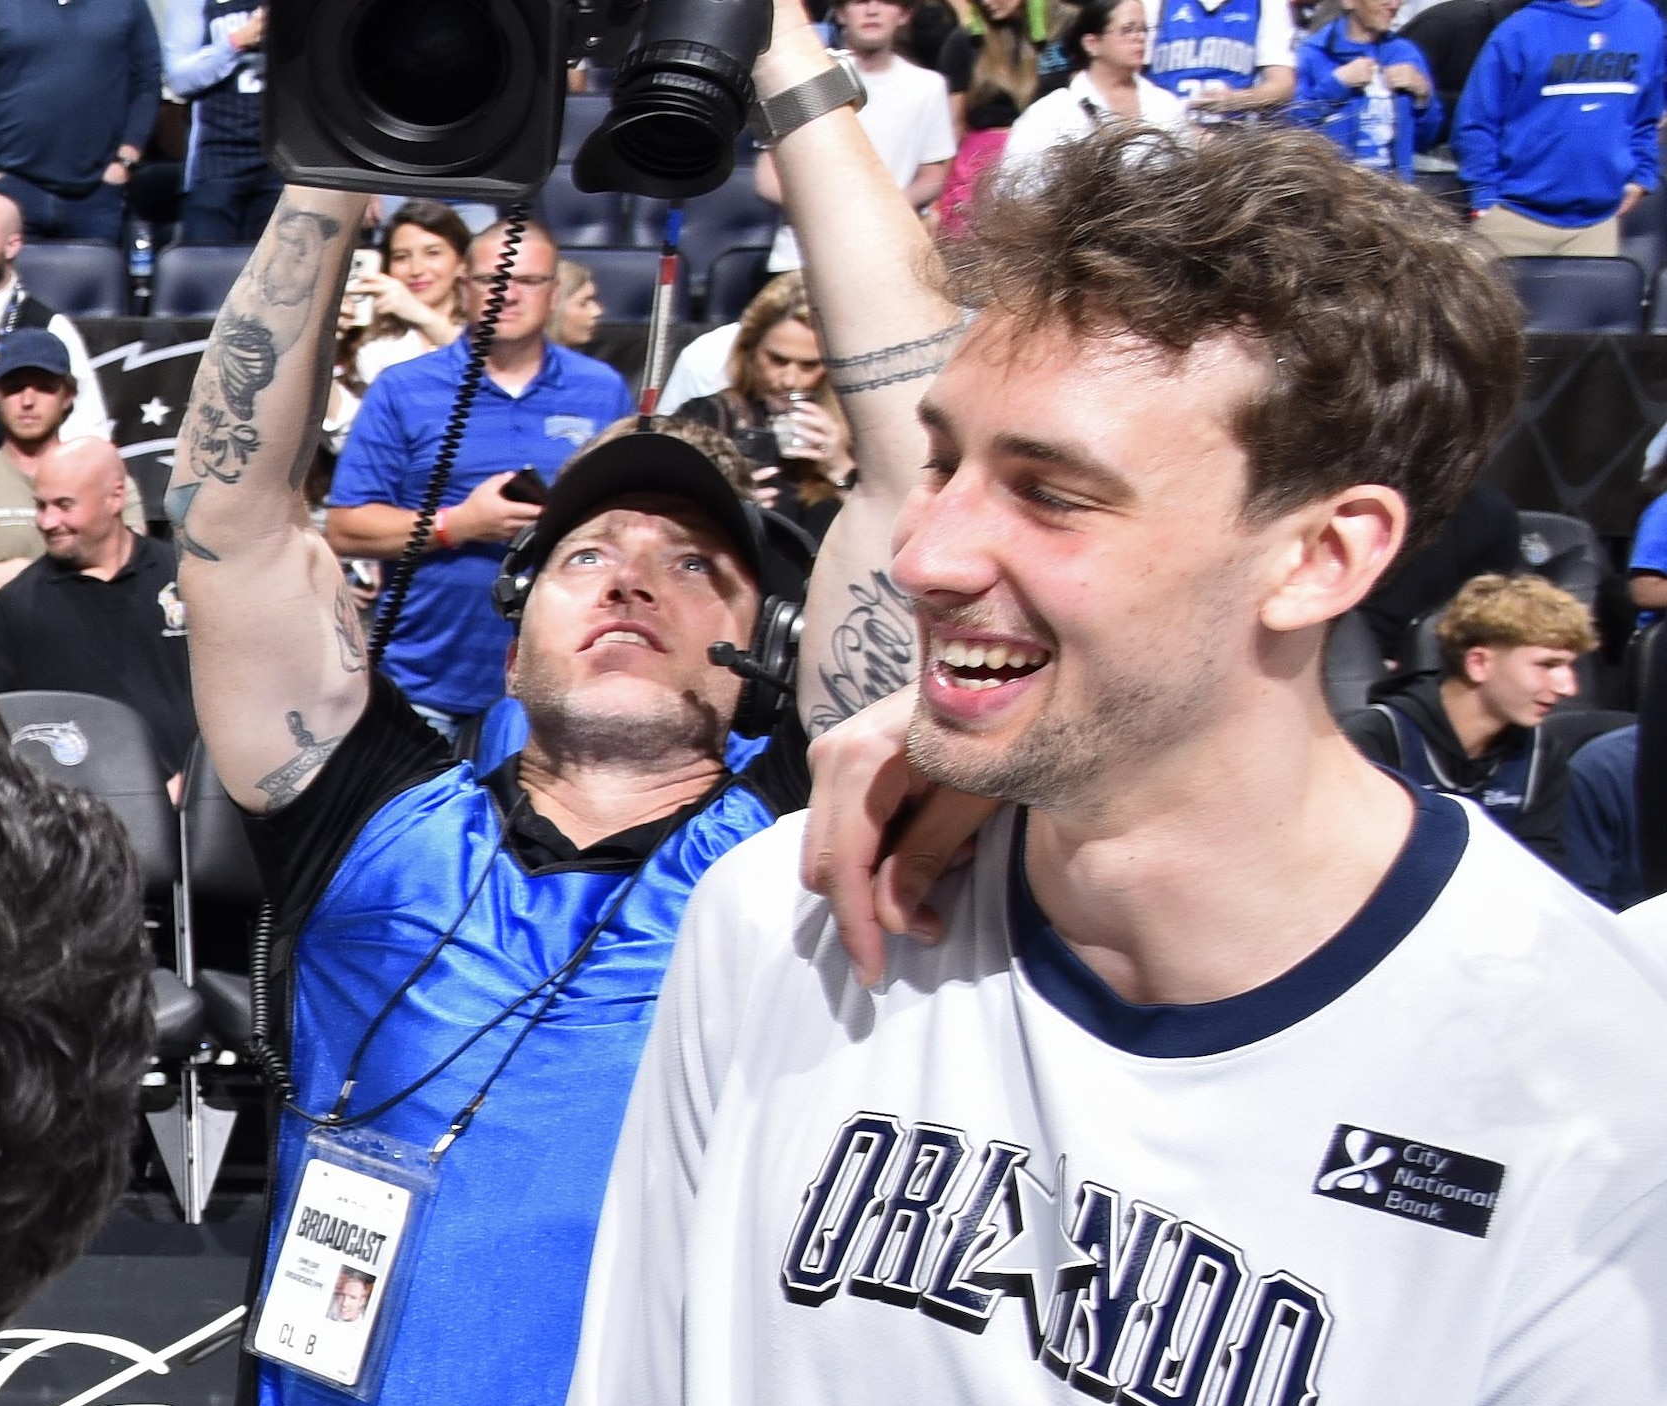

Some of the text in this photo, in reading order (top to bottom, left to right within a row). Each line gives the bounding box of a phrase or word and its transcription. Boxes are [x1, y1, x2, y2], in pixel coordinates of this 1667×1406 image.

[1548, 51, 1640, 84] MAGIC
[1403, 1144, 1451, 1174] City
[1392, 1167, 1498, 1208] National
[1384, 1190, 1449, 1221] Bank
[296, 1206, 387, 1266] BROADCAST
[278, 1324, 317, 1355] CL B
